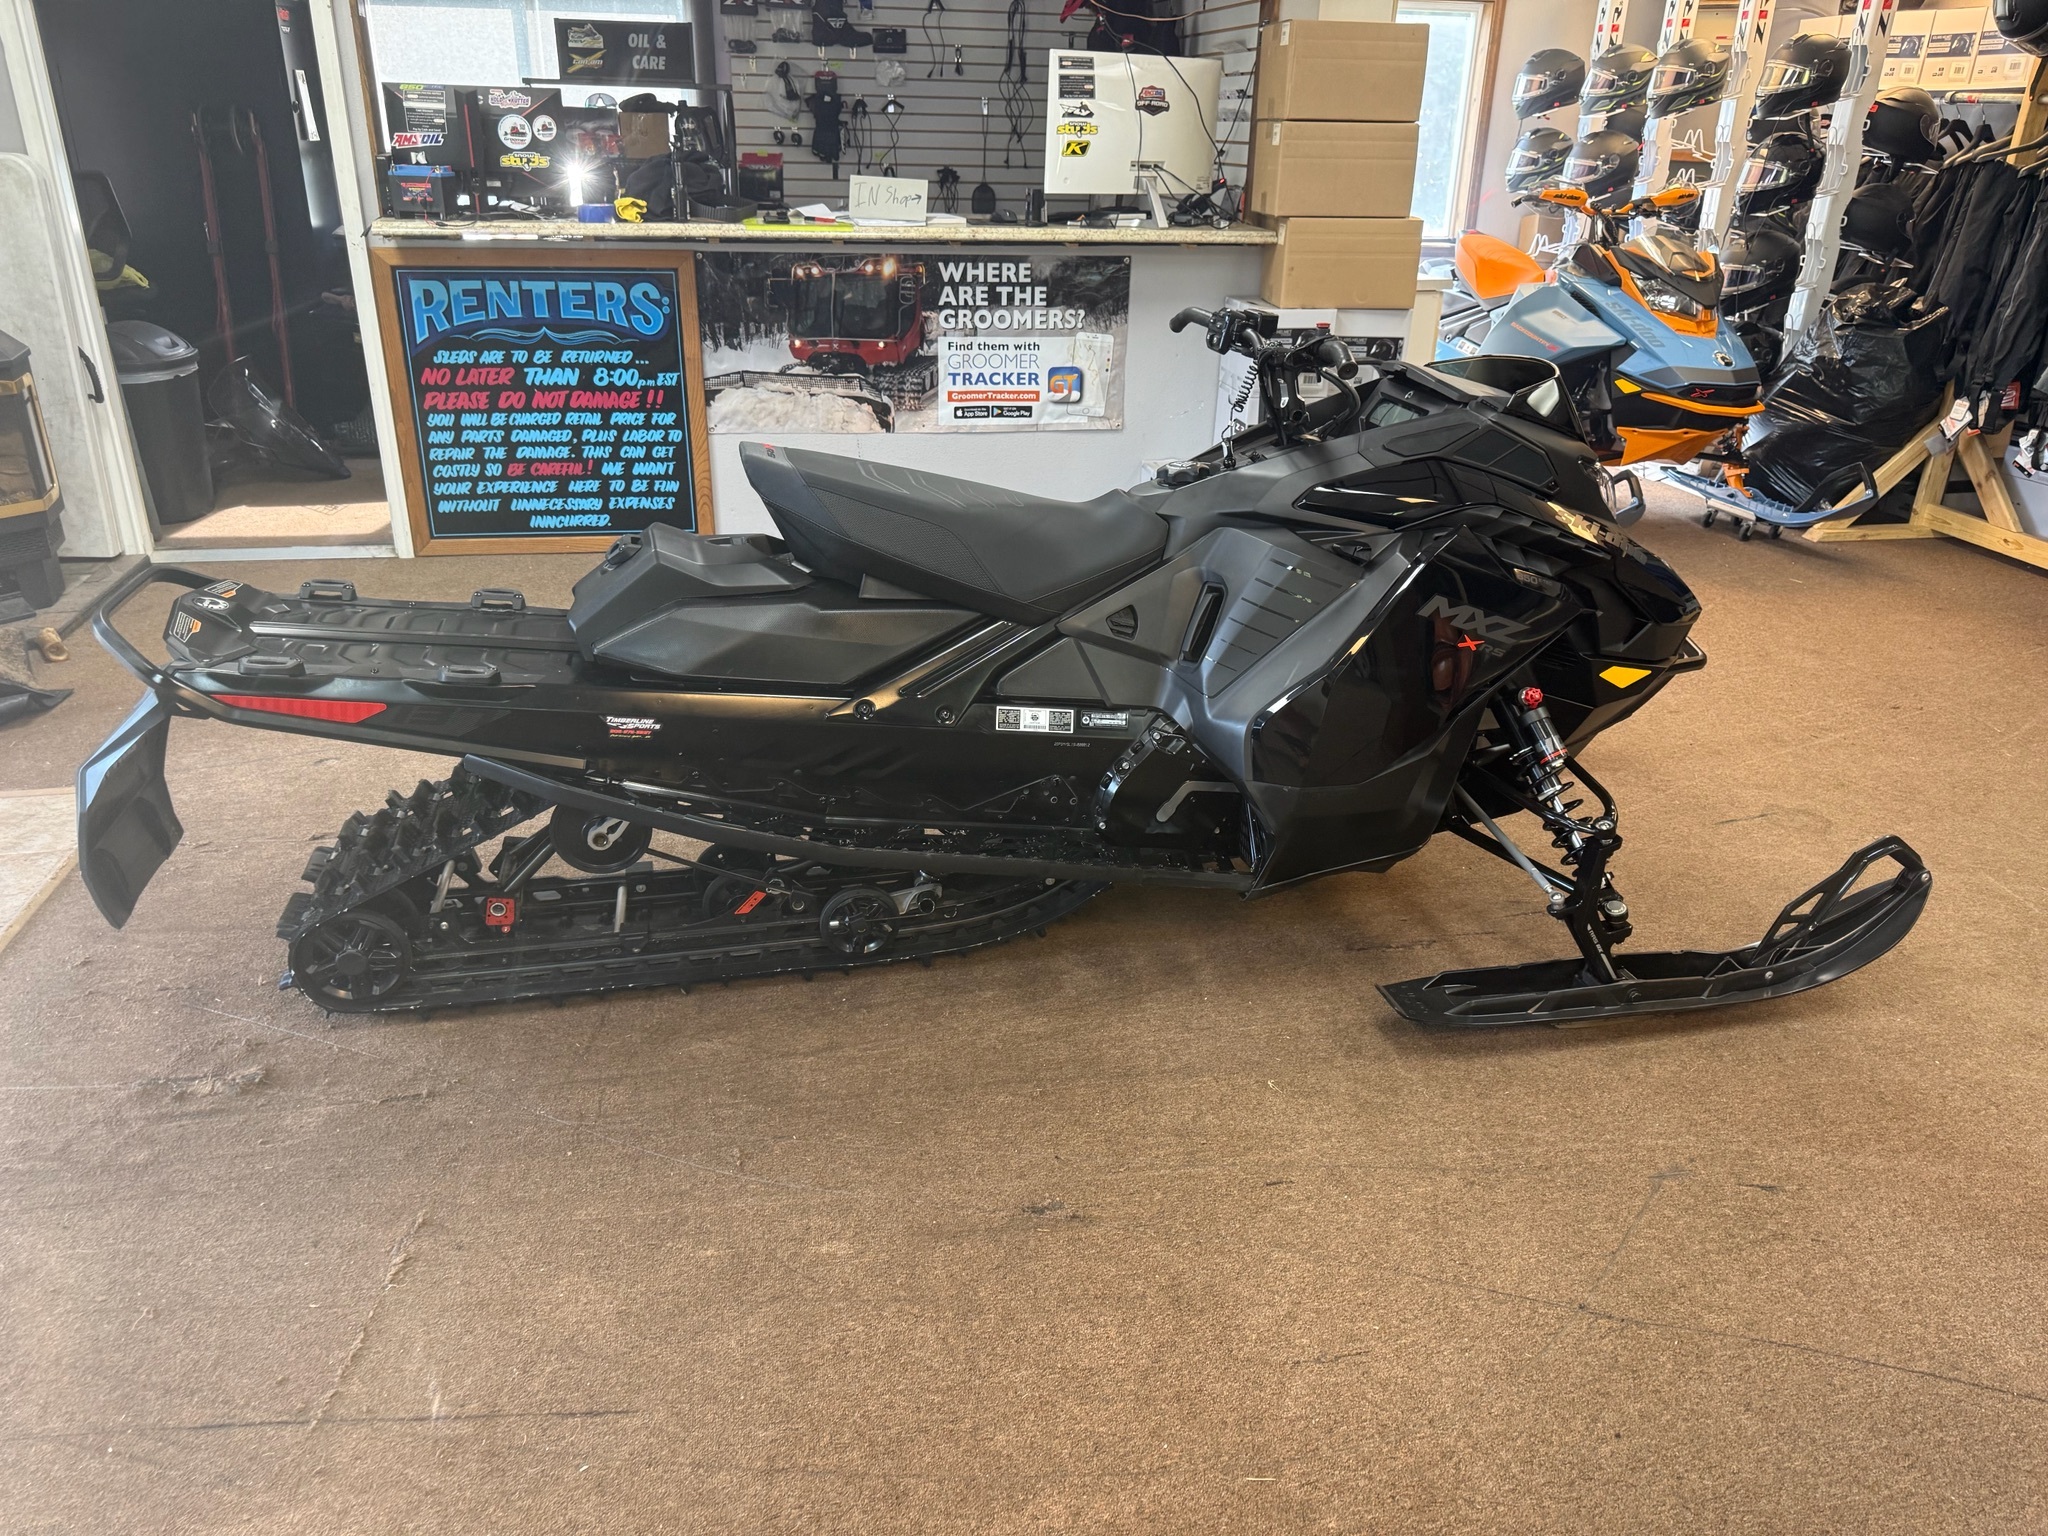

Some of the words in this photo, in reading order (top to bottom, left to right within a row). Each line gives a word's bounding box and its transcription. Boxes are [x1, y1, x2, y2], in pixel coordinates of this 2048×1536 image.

[627, 33, 650, 48] OIL
[655, 34, 667, 49] &
[632, 54, 667, 70] CARE
[395, 134, 443, 147] AMSOIL
[854, 181, 881, 208] IN
[885, 185, 912, 208] Shop
[938, 262, 1033, 284] WHERE
[938, 286, 990, 307] ARE
[996, 286, 1048, 307] THE
[408, 279, 671, 344] RENTERS:
[938, 309, 1087, 330] GROOMERS?
[947, 341, 974, 352] Find
[977, 341, 1010, 352] them
[1014, 341, 1041, 352] with
[433, 350, 478, 364] SLEDS
[480, 350, 506, 364] ARE
[510, 350, 528, 364] TO
[533, 350, 553, 364] BE
[947, 353, 1041, 370] GROOMER
[420, 367, 451, 386] NO
[455, 367, 516, 386] LATER
[523, 367, 580, 386] THAN
[656, 372, 680, 386] EST
[947, 372, 1041, 387] TRACKER
[1049, 373, 1079, 395] GT
[423, 391, 491, 410] PLEASE
[498, 391, 527, 409] DO
[531, 390, 569, 409] NOT
[951, 392, 1037, 401] GroomerTracker.com
[426, 413, 456, 427] YOU
[460, 413, 489, 427] WILL
[490, 412, 509, 427] BE
[508, 412, 562, 426] CHARGED
[564, 411, 604, 426] RETAIL
[609, 411, 648, 426] PRICE
[651, 411, 677, 426] FOR
[427, 430, 455, 444] ANY
[460, 430, 505, 444] PARTS
[510, 429, 577, 444] DAMAGED,
[581, 429, 618, 443] PLUS
[622, 429, 665, 443] LABOR
[667, 429, 683, 443] TO
[429, 447, 476, 461] REPAIR
[482, 446, 508, 460] THE
[515, 446, 576, 460] DAMAGE.
[581, 445, 613, 459] THIS
[620, 445, 647, 459] CAN
[651, 446, 677, 459] GET
[432, 463, 481, 478] COSTLY
[484, 463, 503, 477] SO
[506, 463, 527, 477] BE
[530, 459, 594, 477] CAREFUL!
[601, 461, 626, 476] WE
[631, 461, 677, 476] WANT
[433, 482, 472, 496] YOUR
[476, 480, 559, 495] EXPERIENCE
[568, 480, 603, 493] HERE
[608, 480, 626, 492] TO
[630, 480, 650, 493] BE
[653, 480, 680, 493] FUN
[437, 498, 502, 513] WITHOUT
[510, 497, 603, 512] UNNECESSARY
[608, 496, 676, 510] EXPENSES
[1417, 593, 1532, 645] MXZ
